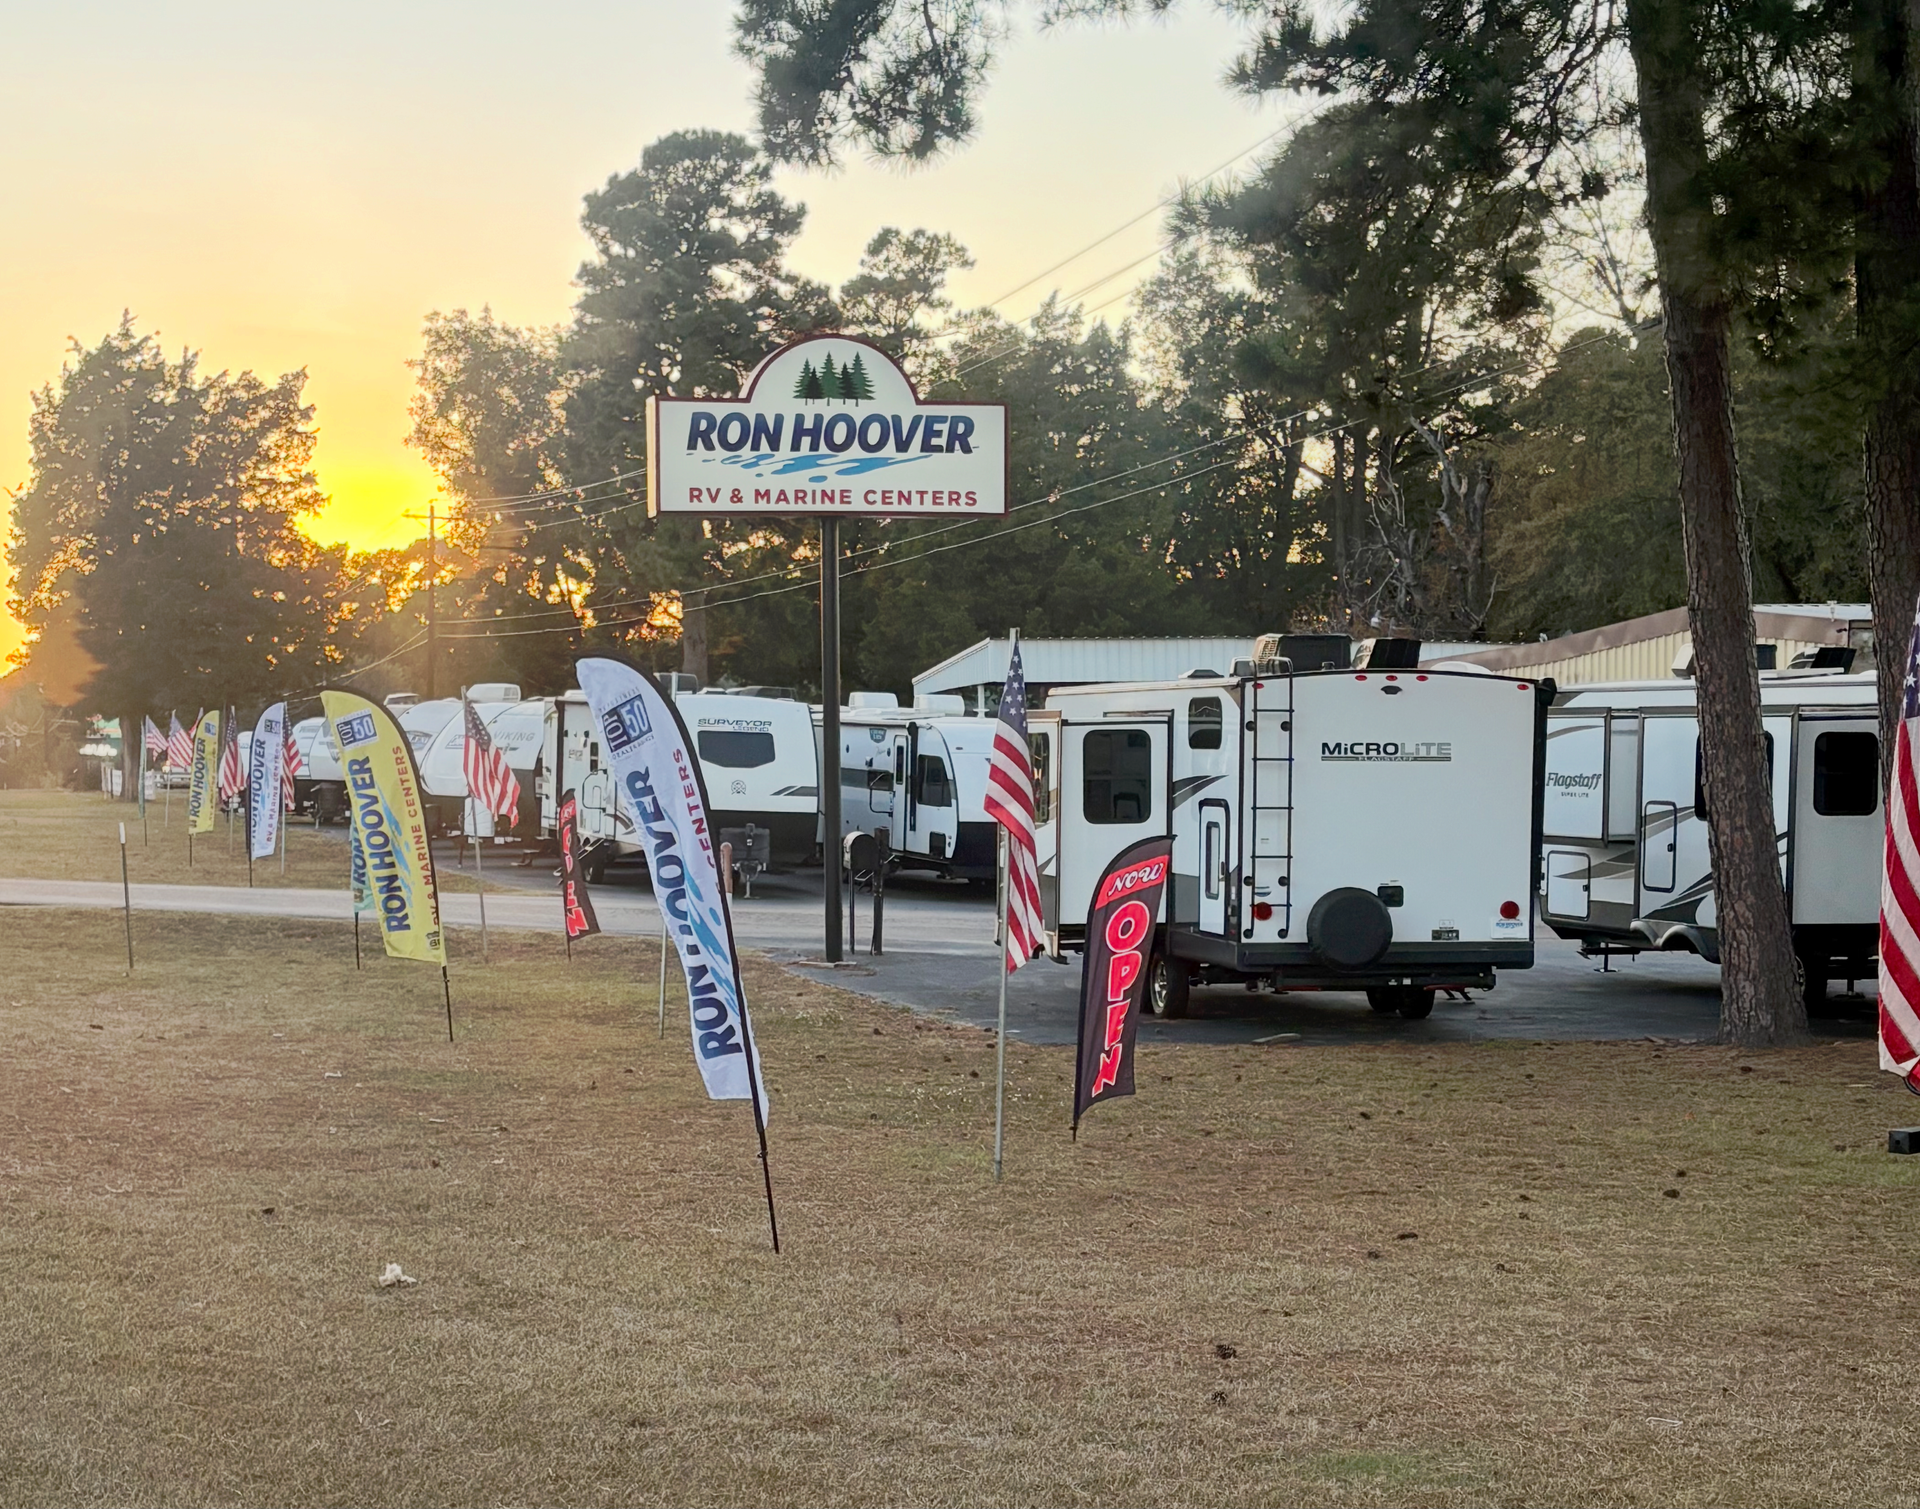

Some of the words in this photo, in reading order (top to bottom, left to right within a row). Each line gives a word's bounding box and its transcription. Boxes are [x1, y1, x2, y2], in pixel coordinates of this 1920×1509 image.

[687, 411, 785, 453] RON
[789, 412, 976, 455] HOOVER
[689, 487, 722, 504] RV
[729, 487, 744, 504] &
[754, 488, 853, 506] MARINE
[863, 489, 979, 507] CENTERS
[337, 723, 355, 747] TOP
[351, 716, 375, 741] 50
[493, 730, 536, 742] VIKING
[603, 714, 629, 752] TOP
[620, 700, 649, 738] 50
[697, 718, 773, 728] SURVEYOR
[192, 737, 206, 791] HOOVER
[392, 745, 418, 818] CENTERS
[1545, 772, 1602, 790] Flagstaff
[190, 788, 200, 818] RON
[348, 755, 397, 871] HOOVER
[411, 823, 433, 886] MARINE
[1107, 862, 1164, 897] NOW
[374, 874, 412, 933] RON
[688, 963, 744, 1061] RON
[1092, 900, 1150, 1097] OPEN
